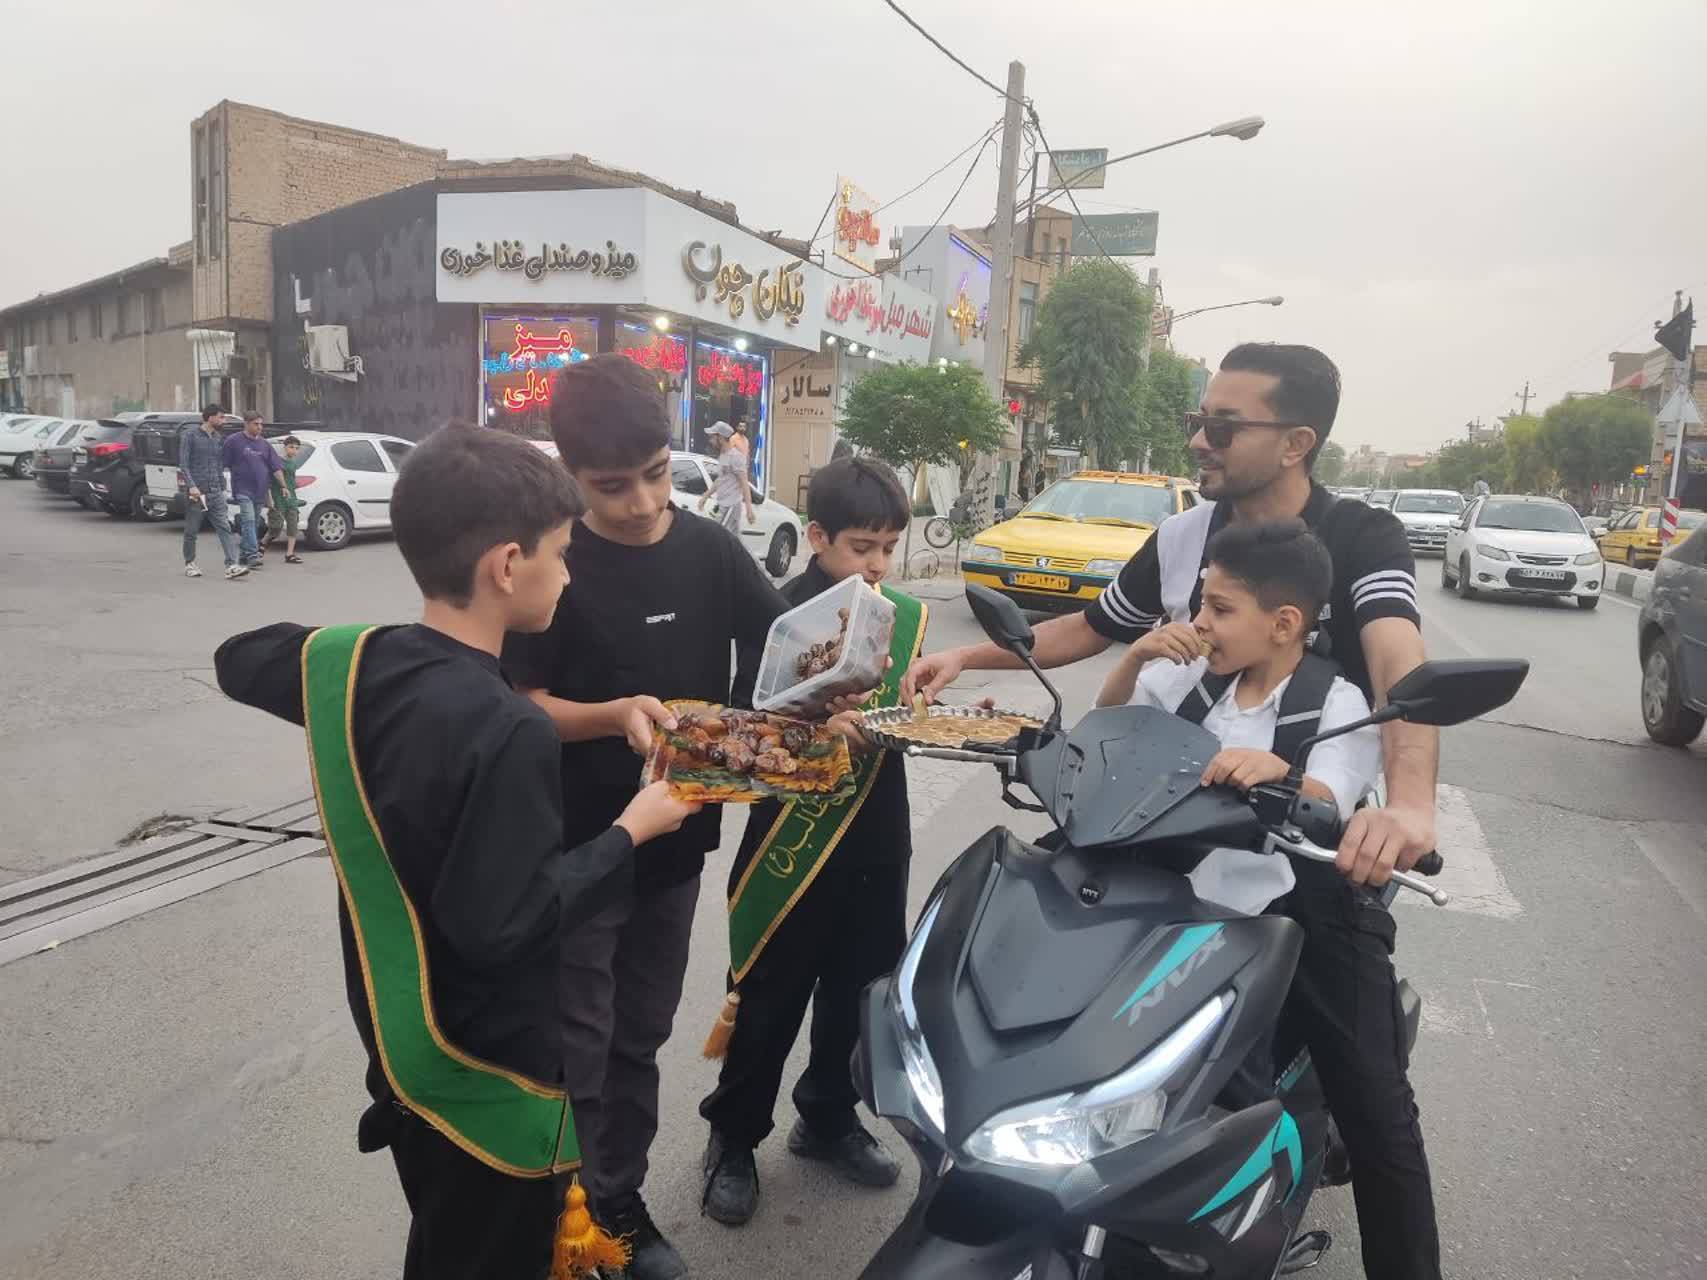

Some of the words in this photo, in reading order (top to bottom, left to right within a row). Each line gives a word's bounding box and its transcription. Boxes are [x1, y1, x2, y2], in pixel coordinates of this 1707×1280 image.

[524, 242, 593, 281] صندلی
[603, 240, 637, 279] میز
[681, 239, 754, 320] چوب
[751, 259, 805, 327] نیکان
[509, 323, 573, 362] میز
[781, 374, 832, 404] سالار
